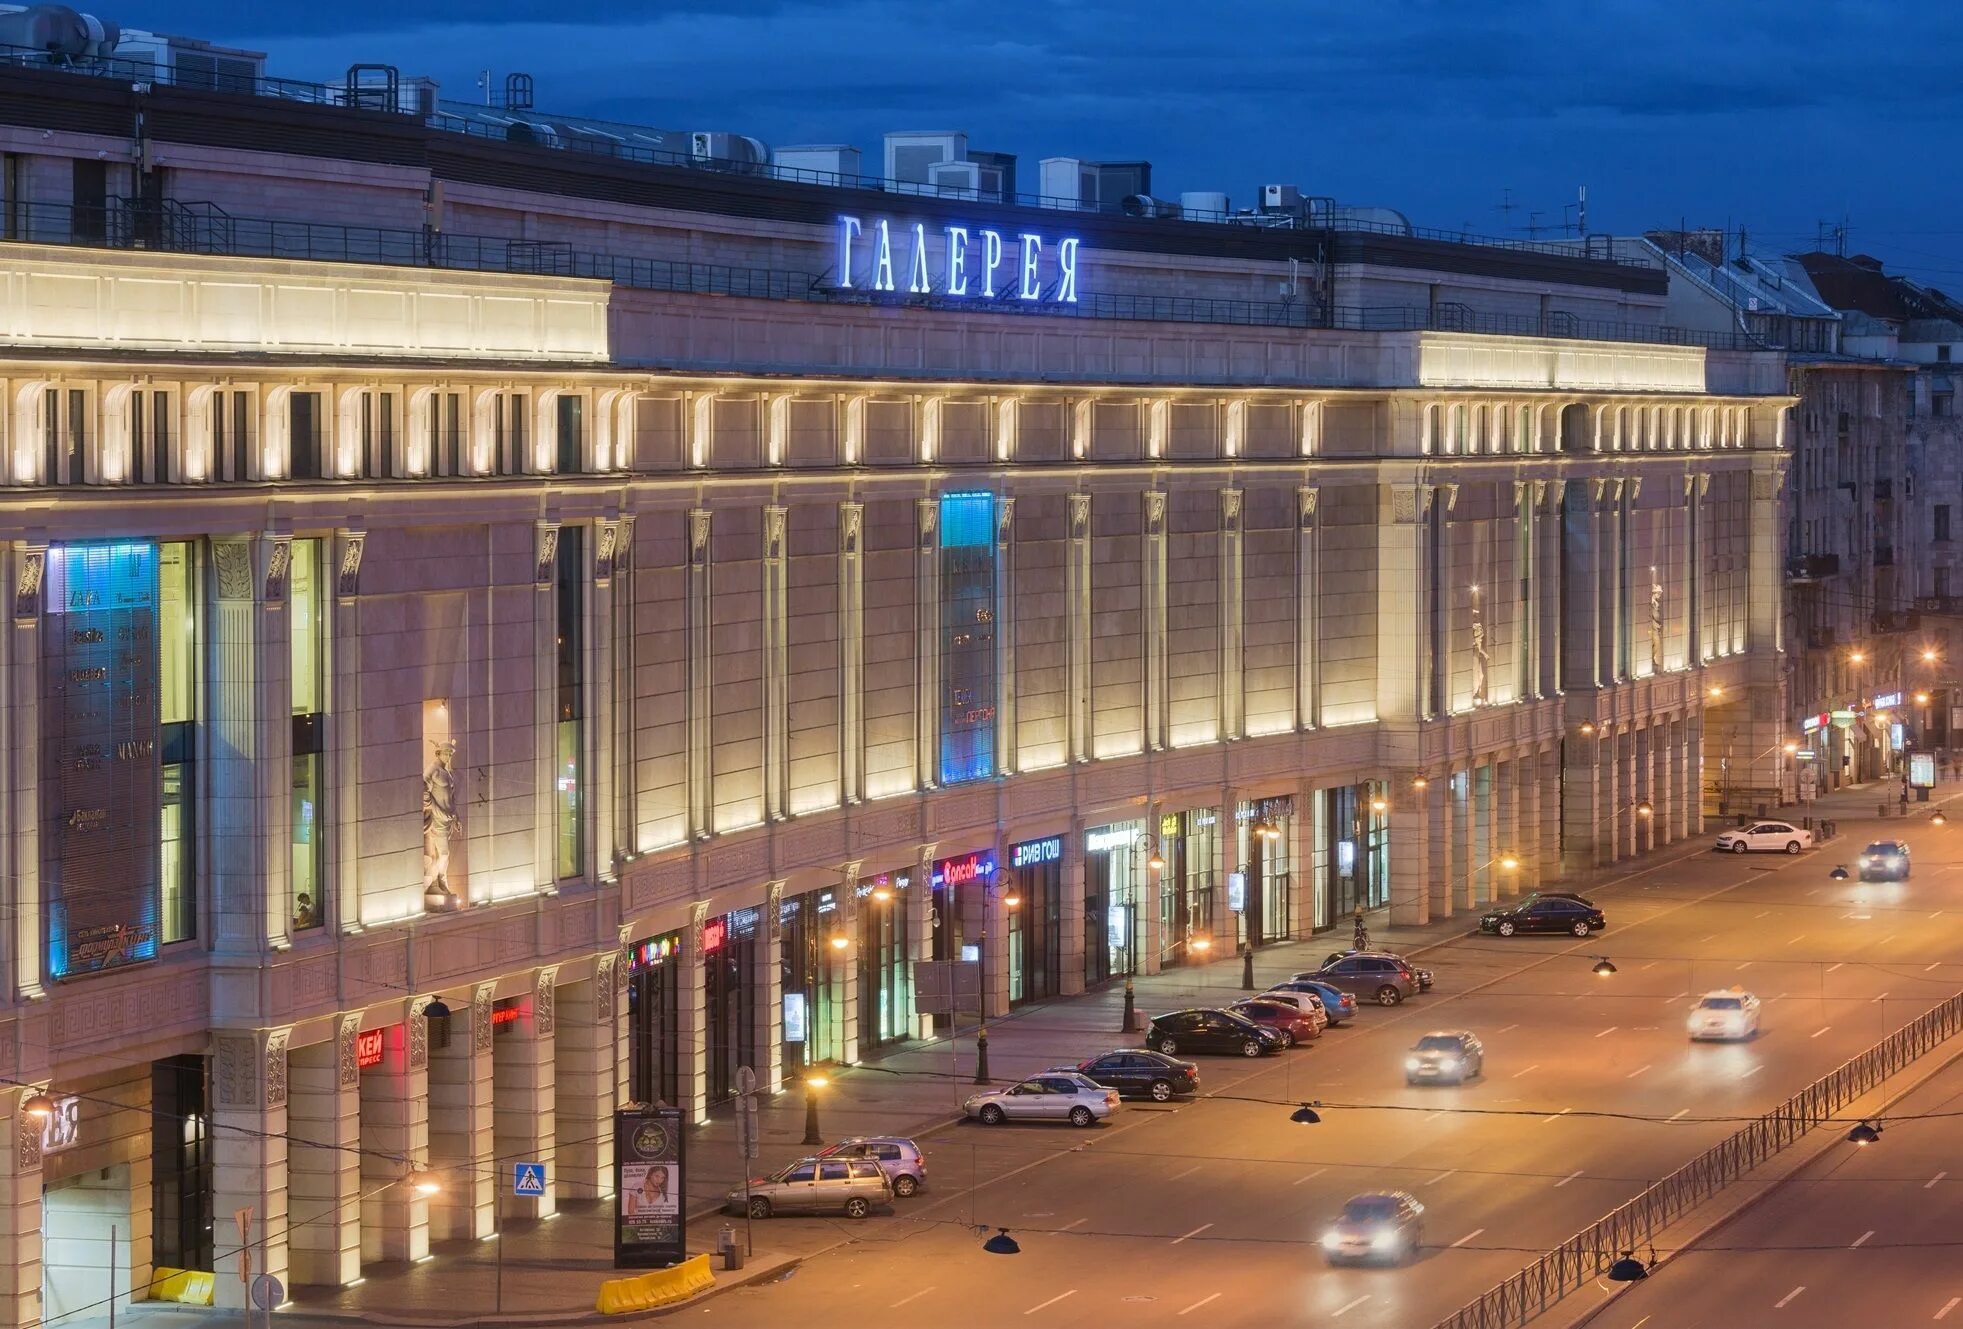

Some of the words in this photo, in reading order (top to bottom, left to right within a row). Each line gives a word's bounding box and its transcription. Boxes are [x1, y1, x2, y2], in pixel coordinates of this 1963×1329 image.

[838, 216, 1079, 302] ГАЛЕРЕЯ
[1023, 844, 1040, 865] РИВ
[1041, 839, 1060, 861] ГОШ
[358, 1030, 382, 1058] КЕЙ
